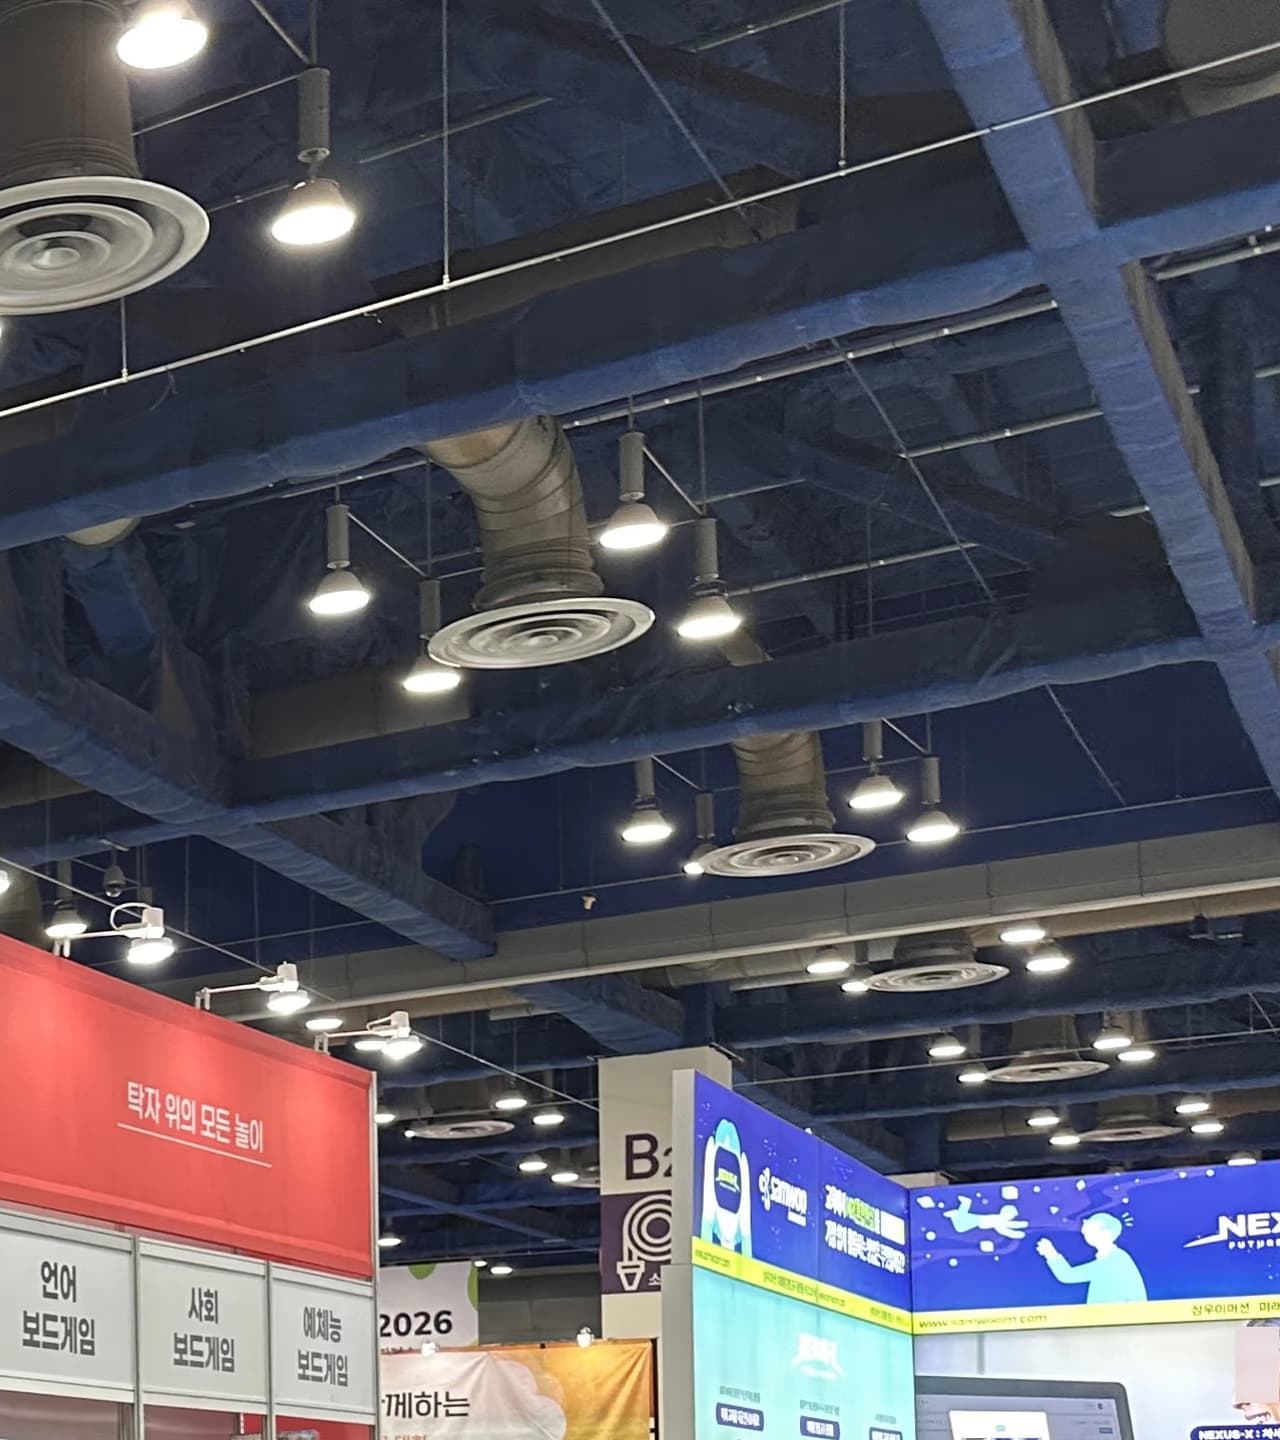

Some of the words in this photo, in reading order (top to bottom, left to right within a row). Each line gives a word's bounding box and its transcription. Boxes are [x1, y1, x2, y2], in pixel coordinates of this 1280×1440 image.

[127, 1081, 162, 1122] 탁자
[164, 1093, 197, 1135] 위의
[200, 1104, 231, 1145] 모든
[234, 1118, 264, 1154] 놀이
[40, 1260, 78, 1303] 언어
[187, 1287, 219, 1325] 사회
[302, 1305, 343, 1343] 예체능
[379, 1310, 454, 1338] 2026
[22, 1309, 96, 1357] 보드게임
[173, 1331, 236, 1373] 보드게임
[296, 1350, 349, 1388] 보드게임
[381, 1391, 471, 1419] 께하는
